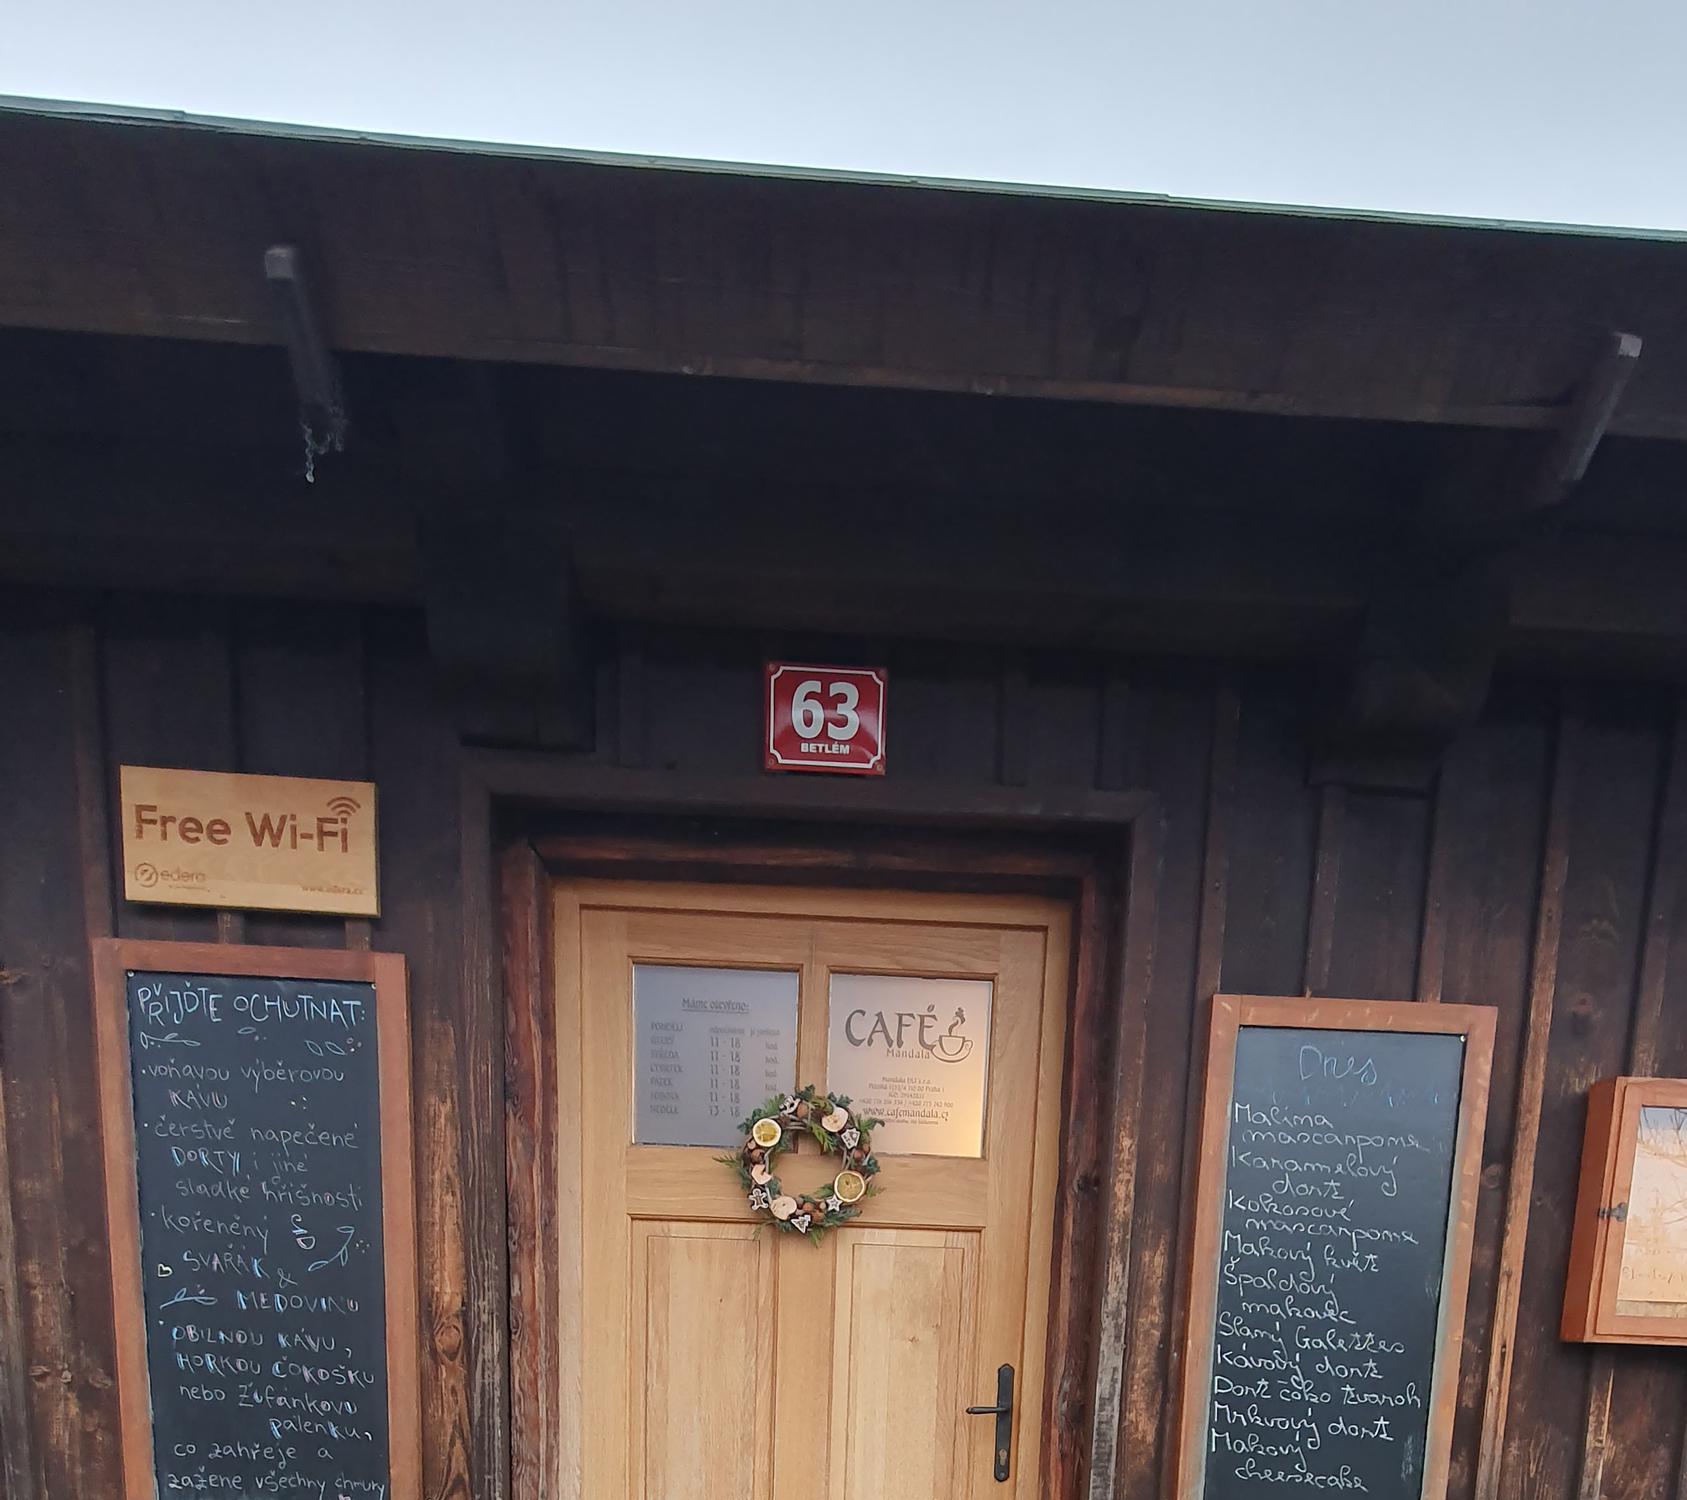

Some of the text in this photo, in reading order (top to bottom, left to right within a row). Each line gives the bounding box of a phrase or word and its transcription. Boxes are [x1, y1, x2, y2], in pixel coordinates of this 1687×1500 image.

[792, 680, 860, 740] 63
[800, 741, 850, 754] BETLÉM
[134, 804, 349, 853] Free Wi-Fi
[137, 981, 366, 1028] PŘIJĎTE OCHUTNAT:
[710, 1037, 719, 1048] 11
[845, 1004, 939, 1051] CAFÉ
[710, 1051, 719, 1062] 11
[710, 1064, 719, 1075] 11
[886, 1048, 931, 1060] Mandala
[1299, 1044, 1377, 1086] Dnes
[149, 1058, 345, 1093] voňavou výběrovou
[710, 1078, 719, 1089] 11
[169, 1083, 228, 1109] KÁVU
[710, 1091, 719, 1102] 11
[1234, 1102, 1334, 1129] Malina
[250, 1123, 359, 1155] napečené
[171, 1147, 241, 1177] DORTY
[1231, 1146, 1399, 1197] Karamelový
[175, 1174, 363, 1211] sladké hříšnosti
[1271, 1173, 1345, 1200] dort
[1228, 1189, 1355, 1222] Kokosové
[1245, 1217, 1419, 1251] mascarpone
[182, 1243, 271, 1279] SVAŘÁK
[1224, 1229, 1380, 1283] Makový květ
[236, 1289, 360, 1315] MEDOVINU
[1223, 1255, 1340, 1316] Špaldový
[1242, 1295, 1358, 1325] makovec
[171, 1323, 264, 1348] OBILNOU
[1218, 1311, 1406, 1367] Slaný Galettes
[176, 1352, 376, 1389] HORKOU ČOKOŠKU
[1217, 1342, 1384, 1390] Kávový dort
[179, 1384, 226, 1401] nebo
[1213, 1374, 1272, 1399] Dort
[1341, 1381, 1422, 1410] tvaroh
[1213, 1400, 1395, 1450] Mrkvový dort
[174, 1441, 334, 1471] co zahřeje a
[1210, 1428, 1308, 1474] Makový
[167, 1465, 244, 1490] zažene
[1234, 1458, 1369, 1494] cheesecake
